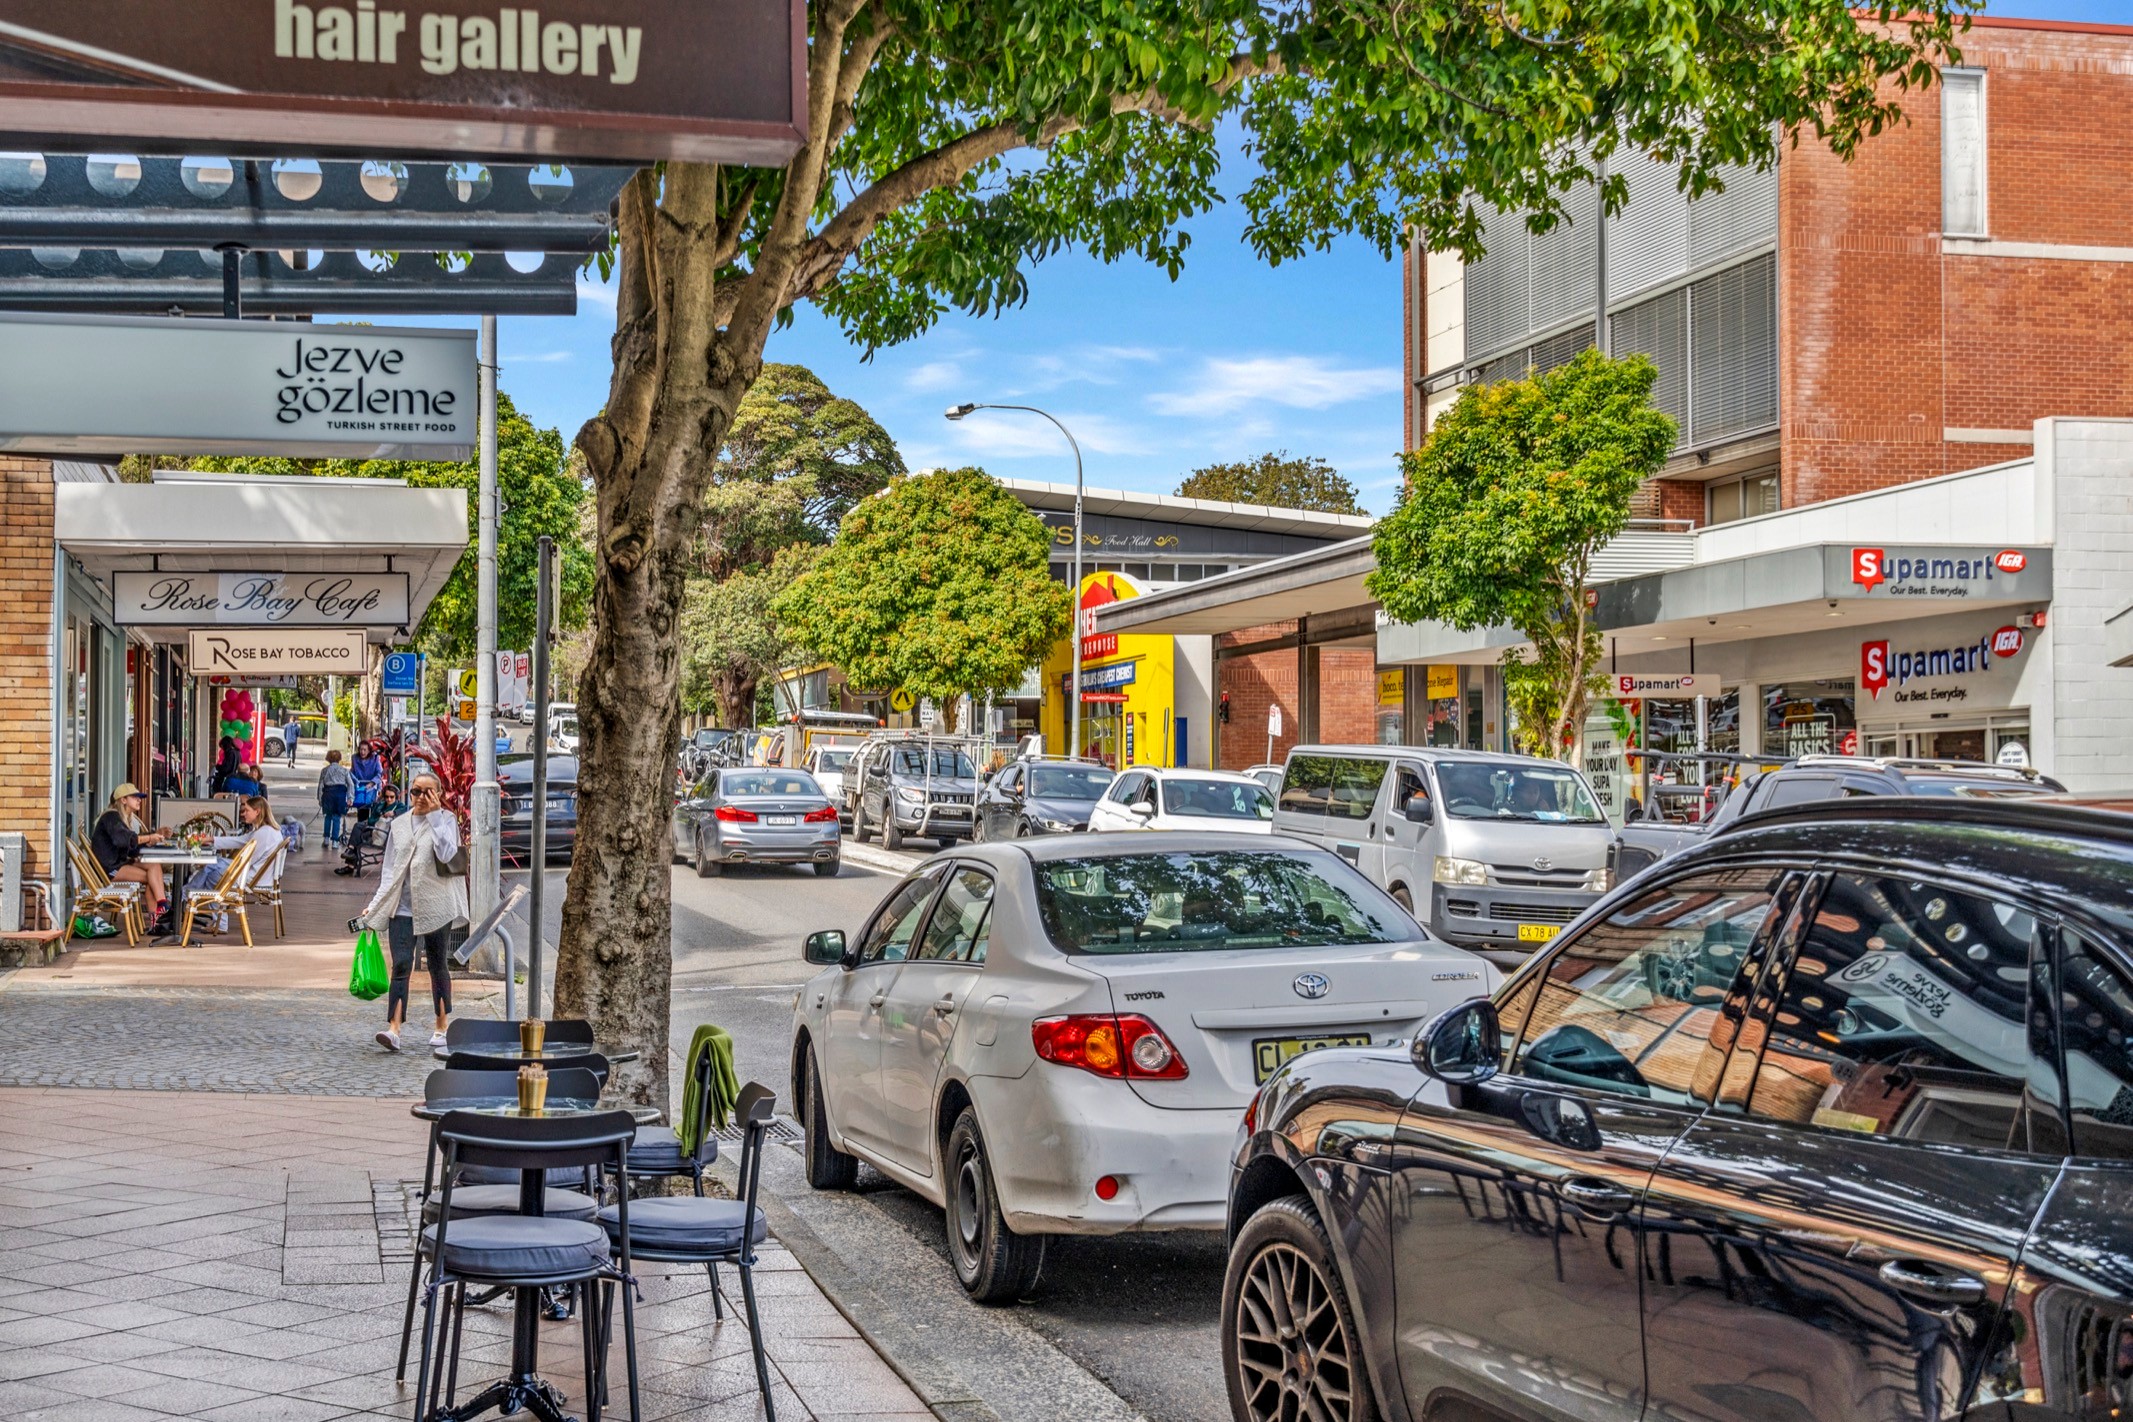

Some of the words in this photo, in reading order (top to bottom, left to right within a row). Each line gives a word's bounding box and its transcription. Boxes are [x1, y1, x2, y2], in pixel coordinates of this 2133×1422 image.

[275, 0, 405, 63] hair
[420, 9, 642, 85] gallery
[276, 338, 404, 379] Jezve
[276, 376, 456, 424] gözleme
[327, 421, 375, 430] TURKISH
[380, 422, 420, 431] STREET
[425, 423, 456, 432] FOOD
[1104, 534, 1126, 546] Food
[1128, 535, 1151, 547] Hall
[1859, 553, 1993, 584] Supamart
[1890, 586, 1905, 595] Our
[1908, 586, 1927, 595] Best.
[141, 577, 220, 611] Rose
[224, 577, 304, 621] Bay
[304, 578, 381, 620] Café
[207, 637, 257, 670] ROSE
[260, 647, 283, 659] BAY
[288, 647, 351, 659] TOBACCO
[1867, 635, 1990, 687] Supamart
[1623, 677, 1680, 690] Supamart
[1894, 691, 1909, 703] Our
[1910, 690, 1929, 702] Best.
[1677, 730, 1691, 745] ALL
[1791, 722, 1808, 739] ALL
[1810, 721, 1829, 737] THE
[1789, 738, 1831, 758] BASICS
[1586, 758, 1603, 772] YOUR
[1592, 775, 1611, 790] SUPA
[1520, 926, 1531, 937] CX
[1534, 927, 1545, 938] 78
[1123, 990, 1166, 1002] TOYOTA
